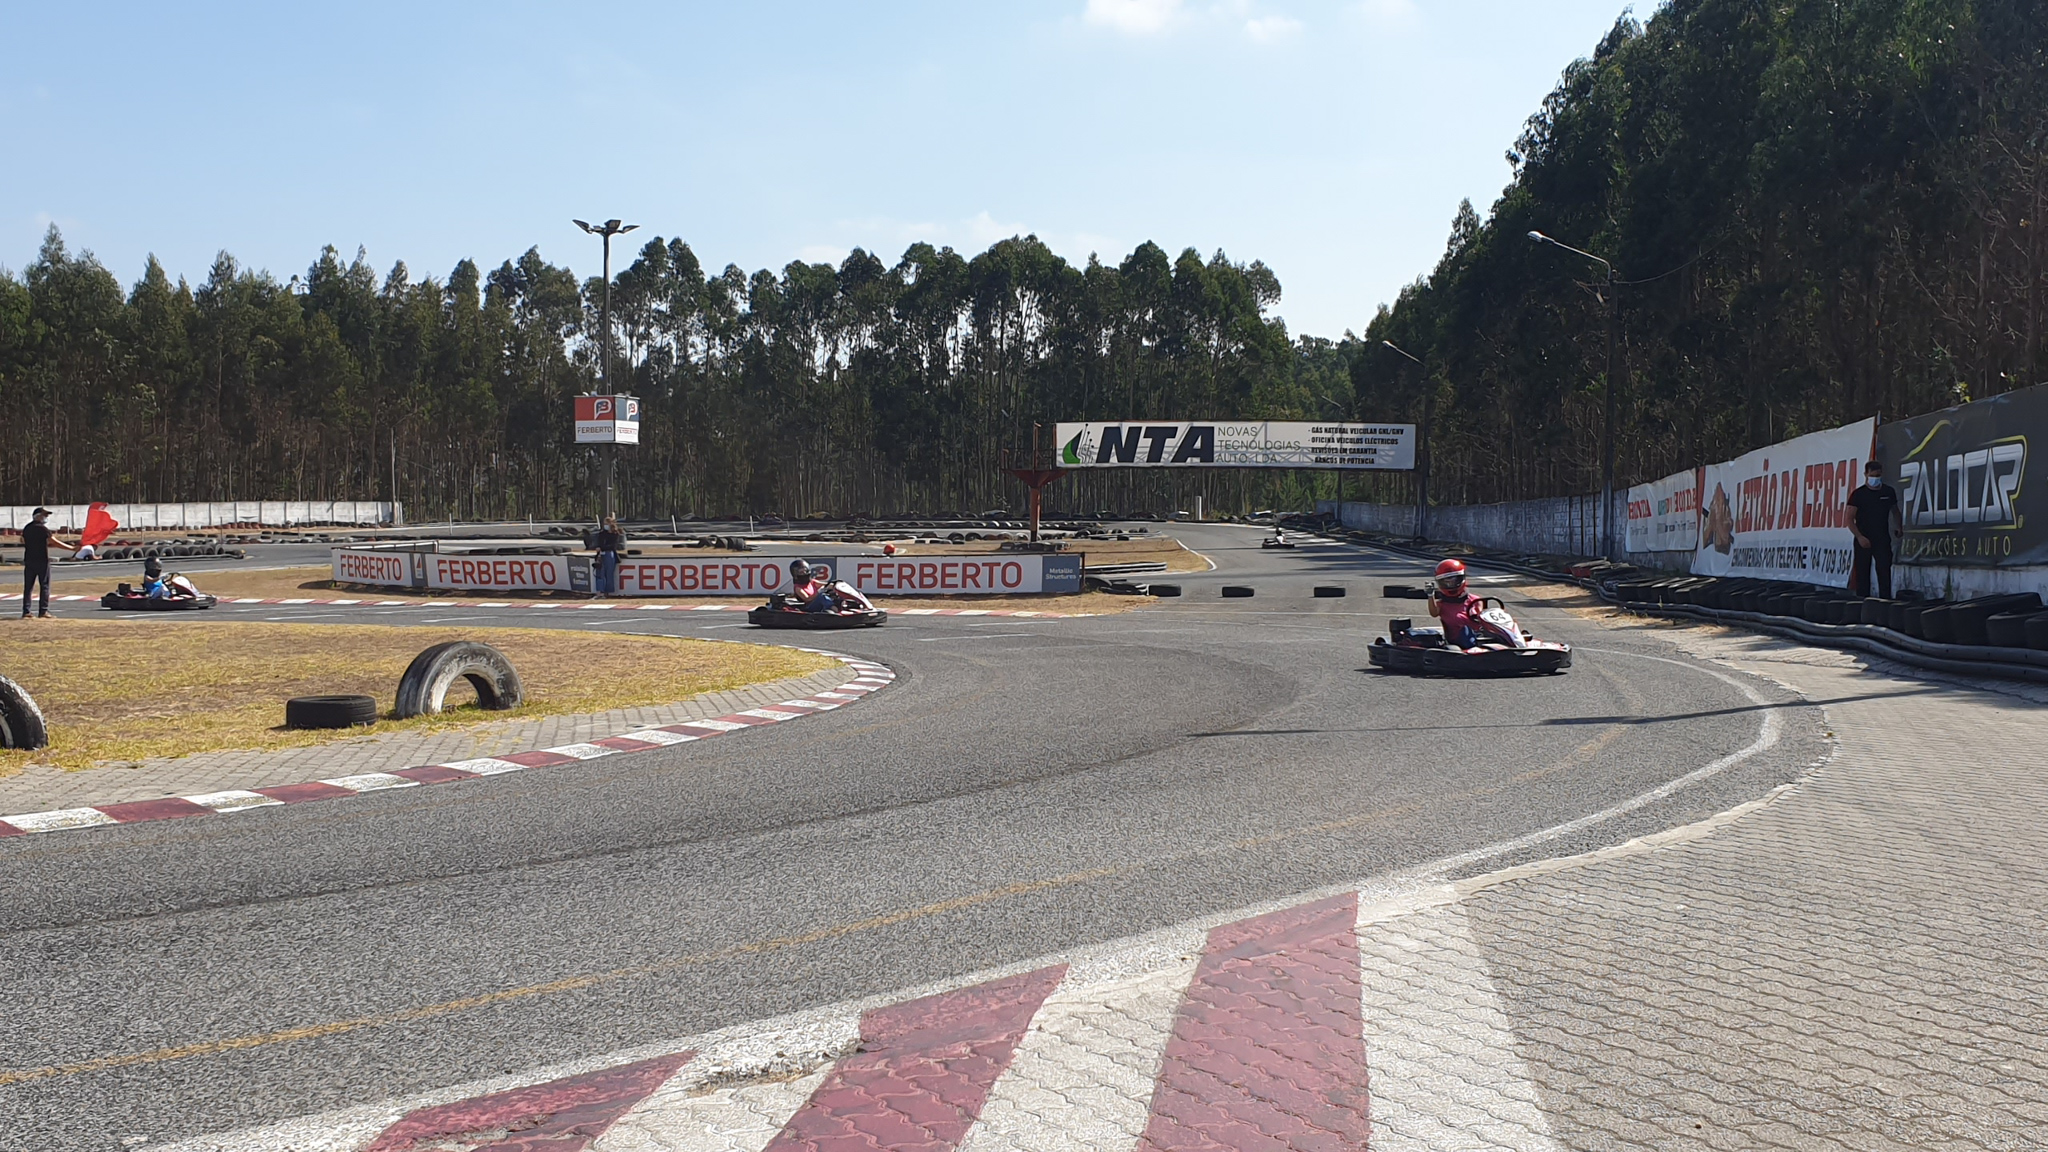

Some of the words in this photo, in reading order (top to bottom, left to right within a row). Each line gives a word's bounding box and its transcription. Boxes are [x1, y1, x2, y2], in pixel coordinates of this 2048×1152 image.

[577, 426, 613, 434] FERBERTO
[1217, 427, 1257, 437] NOVAS
[1311, 436, 1335, 444] OFICINA
[1324, 427, 1349, 435] NATURAL
[1096, 426, 1215, 464] NTA
[1348, 447, 1377, 455] GARANTIA
[1900, 443, 2024, 526] PALOCAR
[1777, 468, 1798, 530] DA
[1976, 535, 2011, 556] AUTO
[340, 554, 402, 581] FERBERTO
[437, 559, 556, 585] FERBERTO
[619, 564, 781, 590] FERBERTO
[857, 562, 1023, 589] FERBERTO
[1489, 612, 1506, 621] 64
